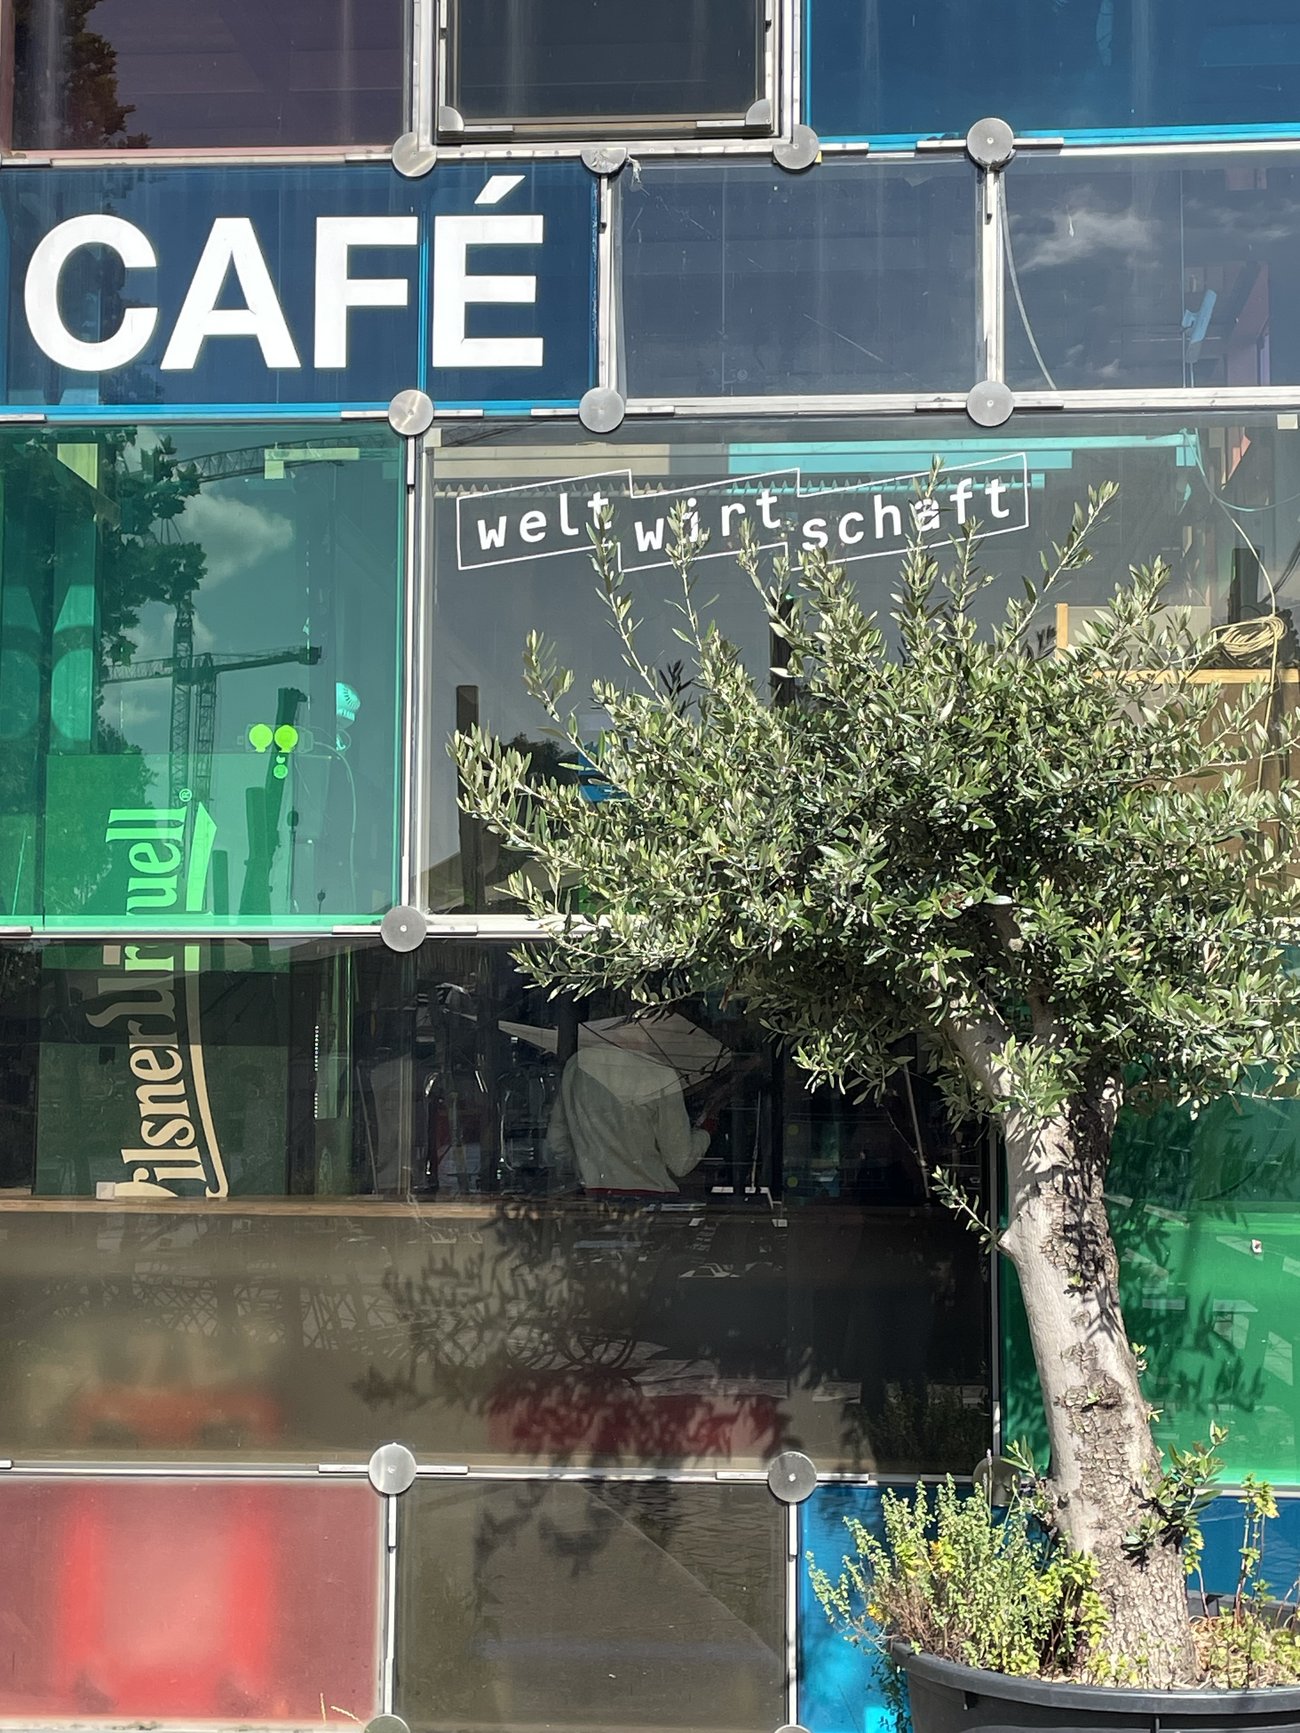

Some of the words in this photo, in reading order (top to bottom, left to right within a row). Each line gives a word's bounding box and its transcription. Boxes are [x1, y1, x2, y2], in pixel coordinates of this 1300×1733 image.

[24, 175, 544, 372] CAFÉ
[476, 491, 613, 551] welt
[801, 477, 1010, 552] schaft
[86, 806, 213, 1028] Uruell
